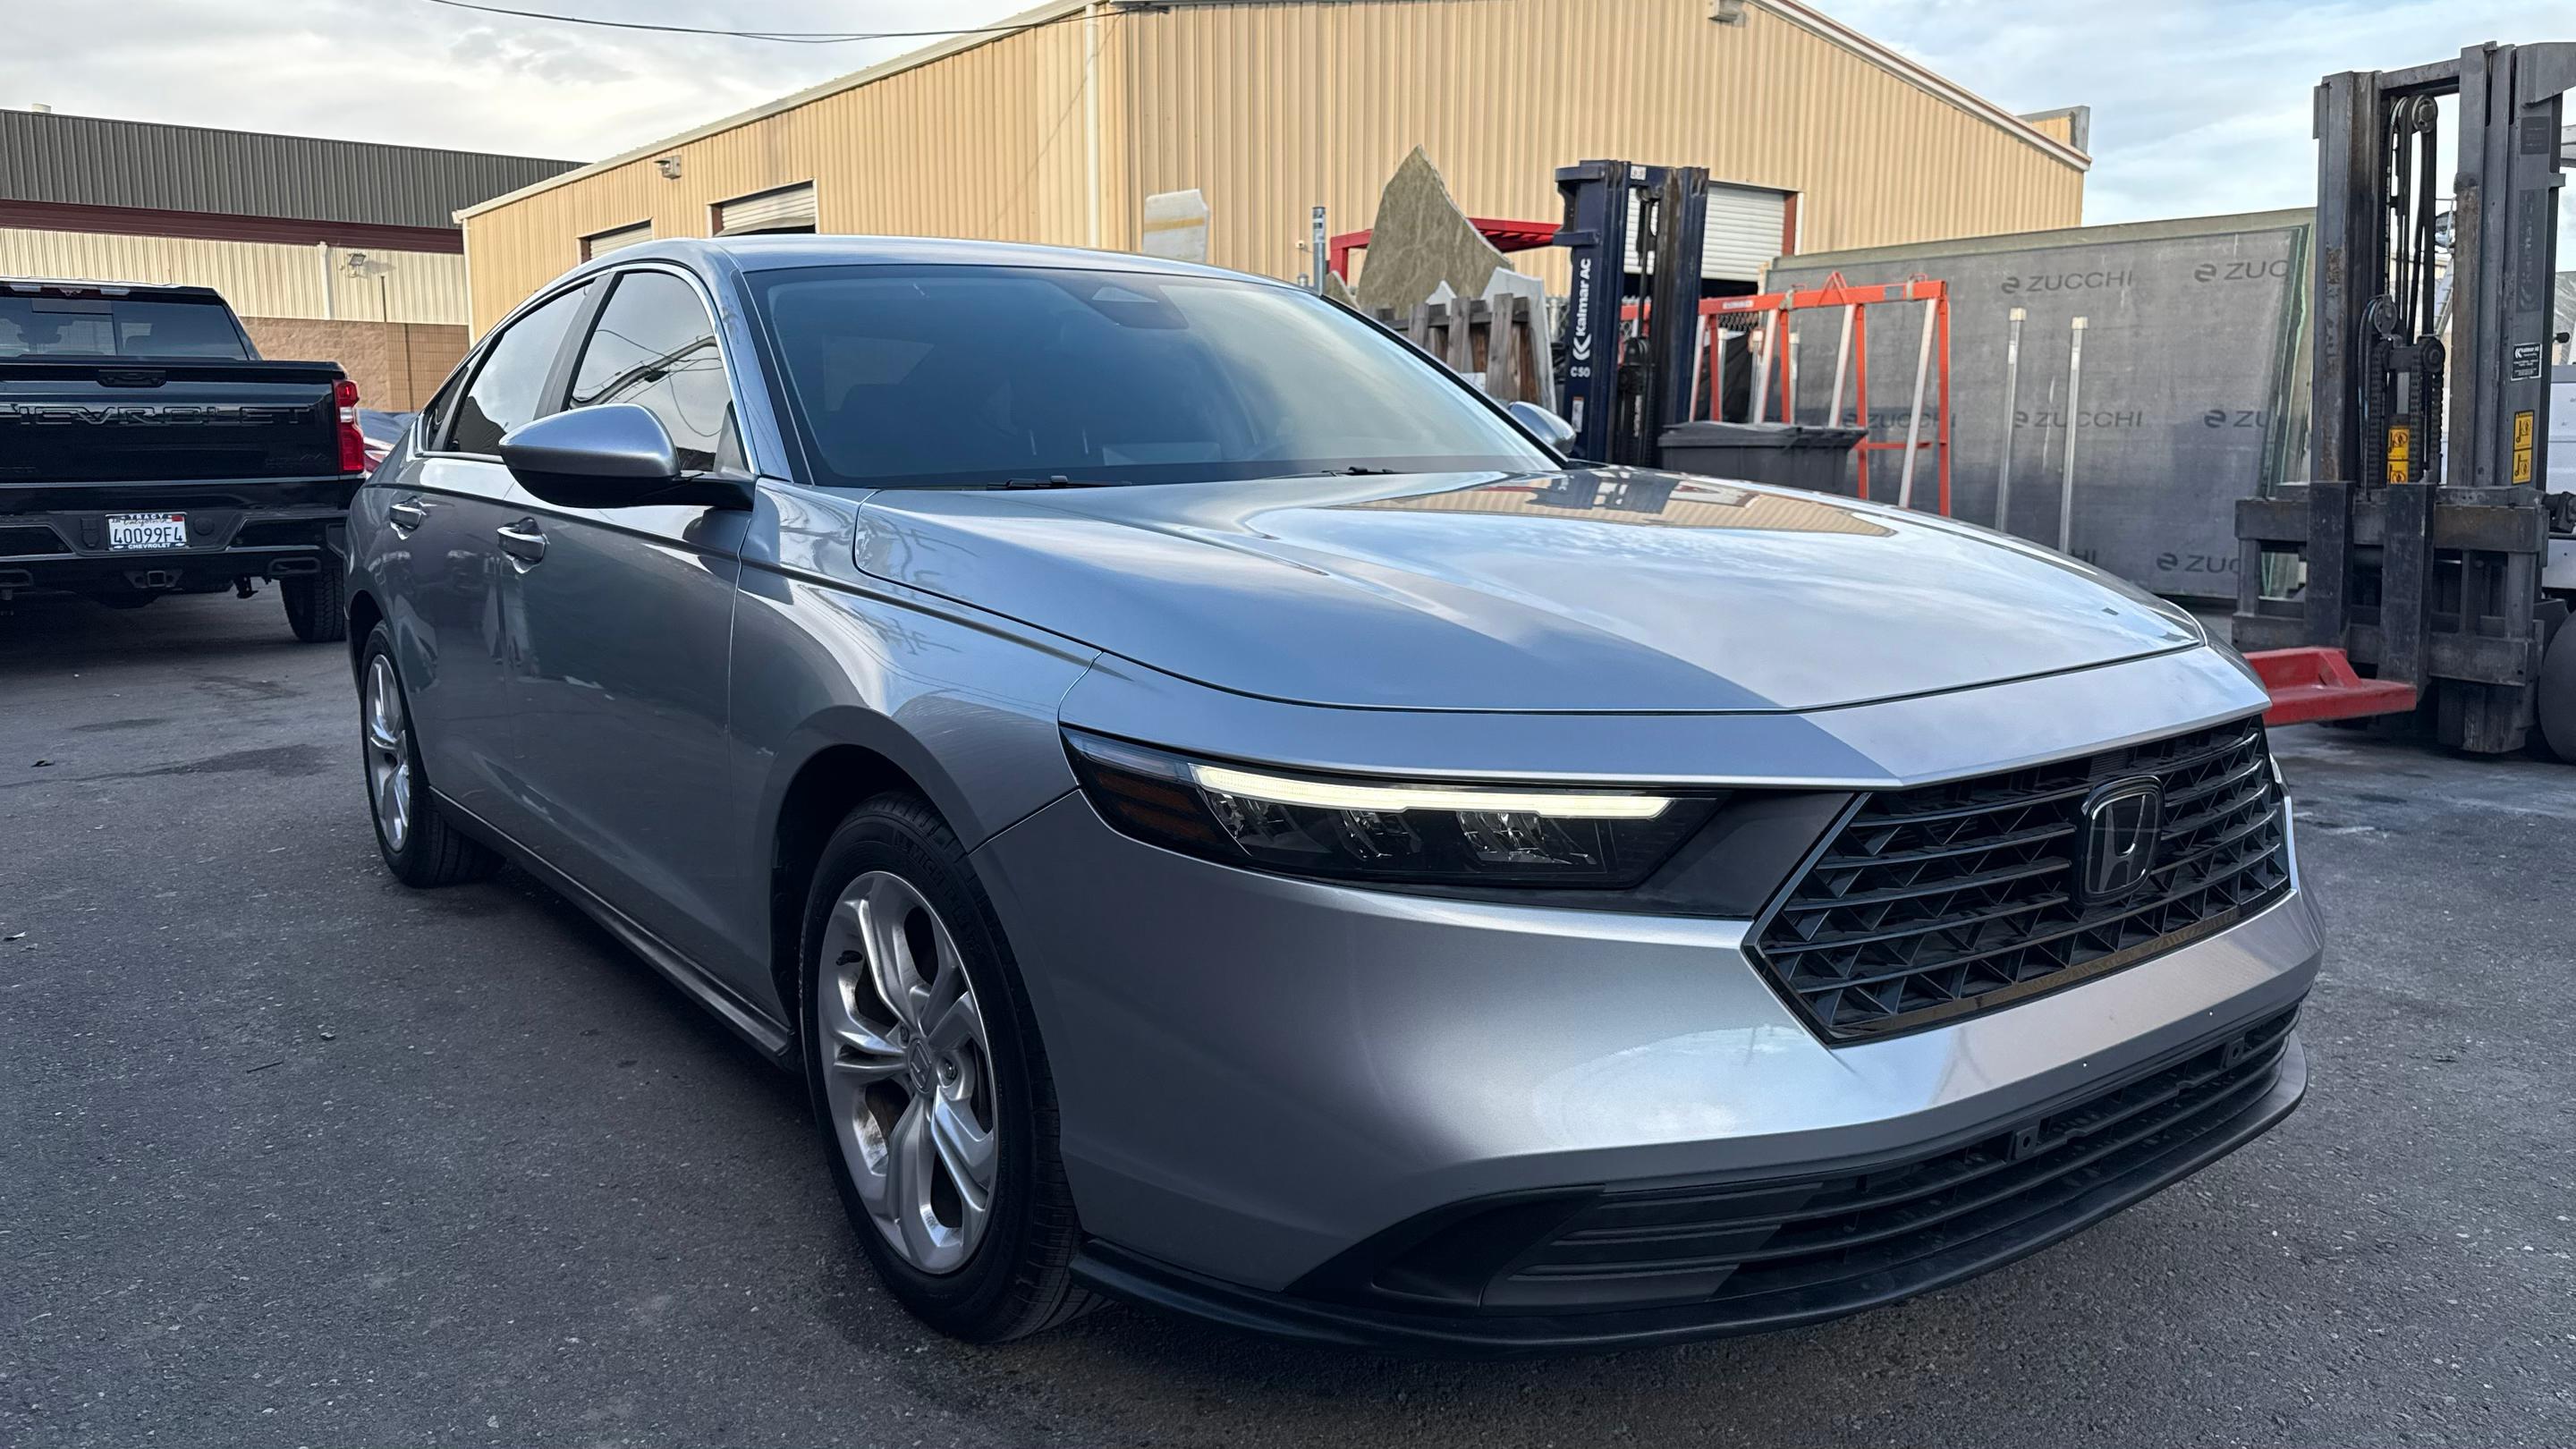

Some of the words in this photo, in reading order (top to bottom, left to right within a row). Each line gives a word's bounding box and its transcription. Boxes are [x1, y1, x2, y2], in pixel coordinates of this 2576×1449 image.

[1580, 258, 1591, 279] AC
[2025, 270, 2132, 292] ZUCCHI
[1575, 280, 1589, 336] Kalmar
[2034, 411, 2142, 428] ZUCCHI
[114, 527, 182, 544] 40099F4
